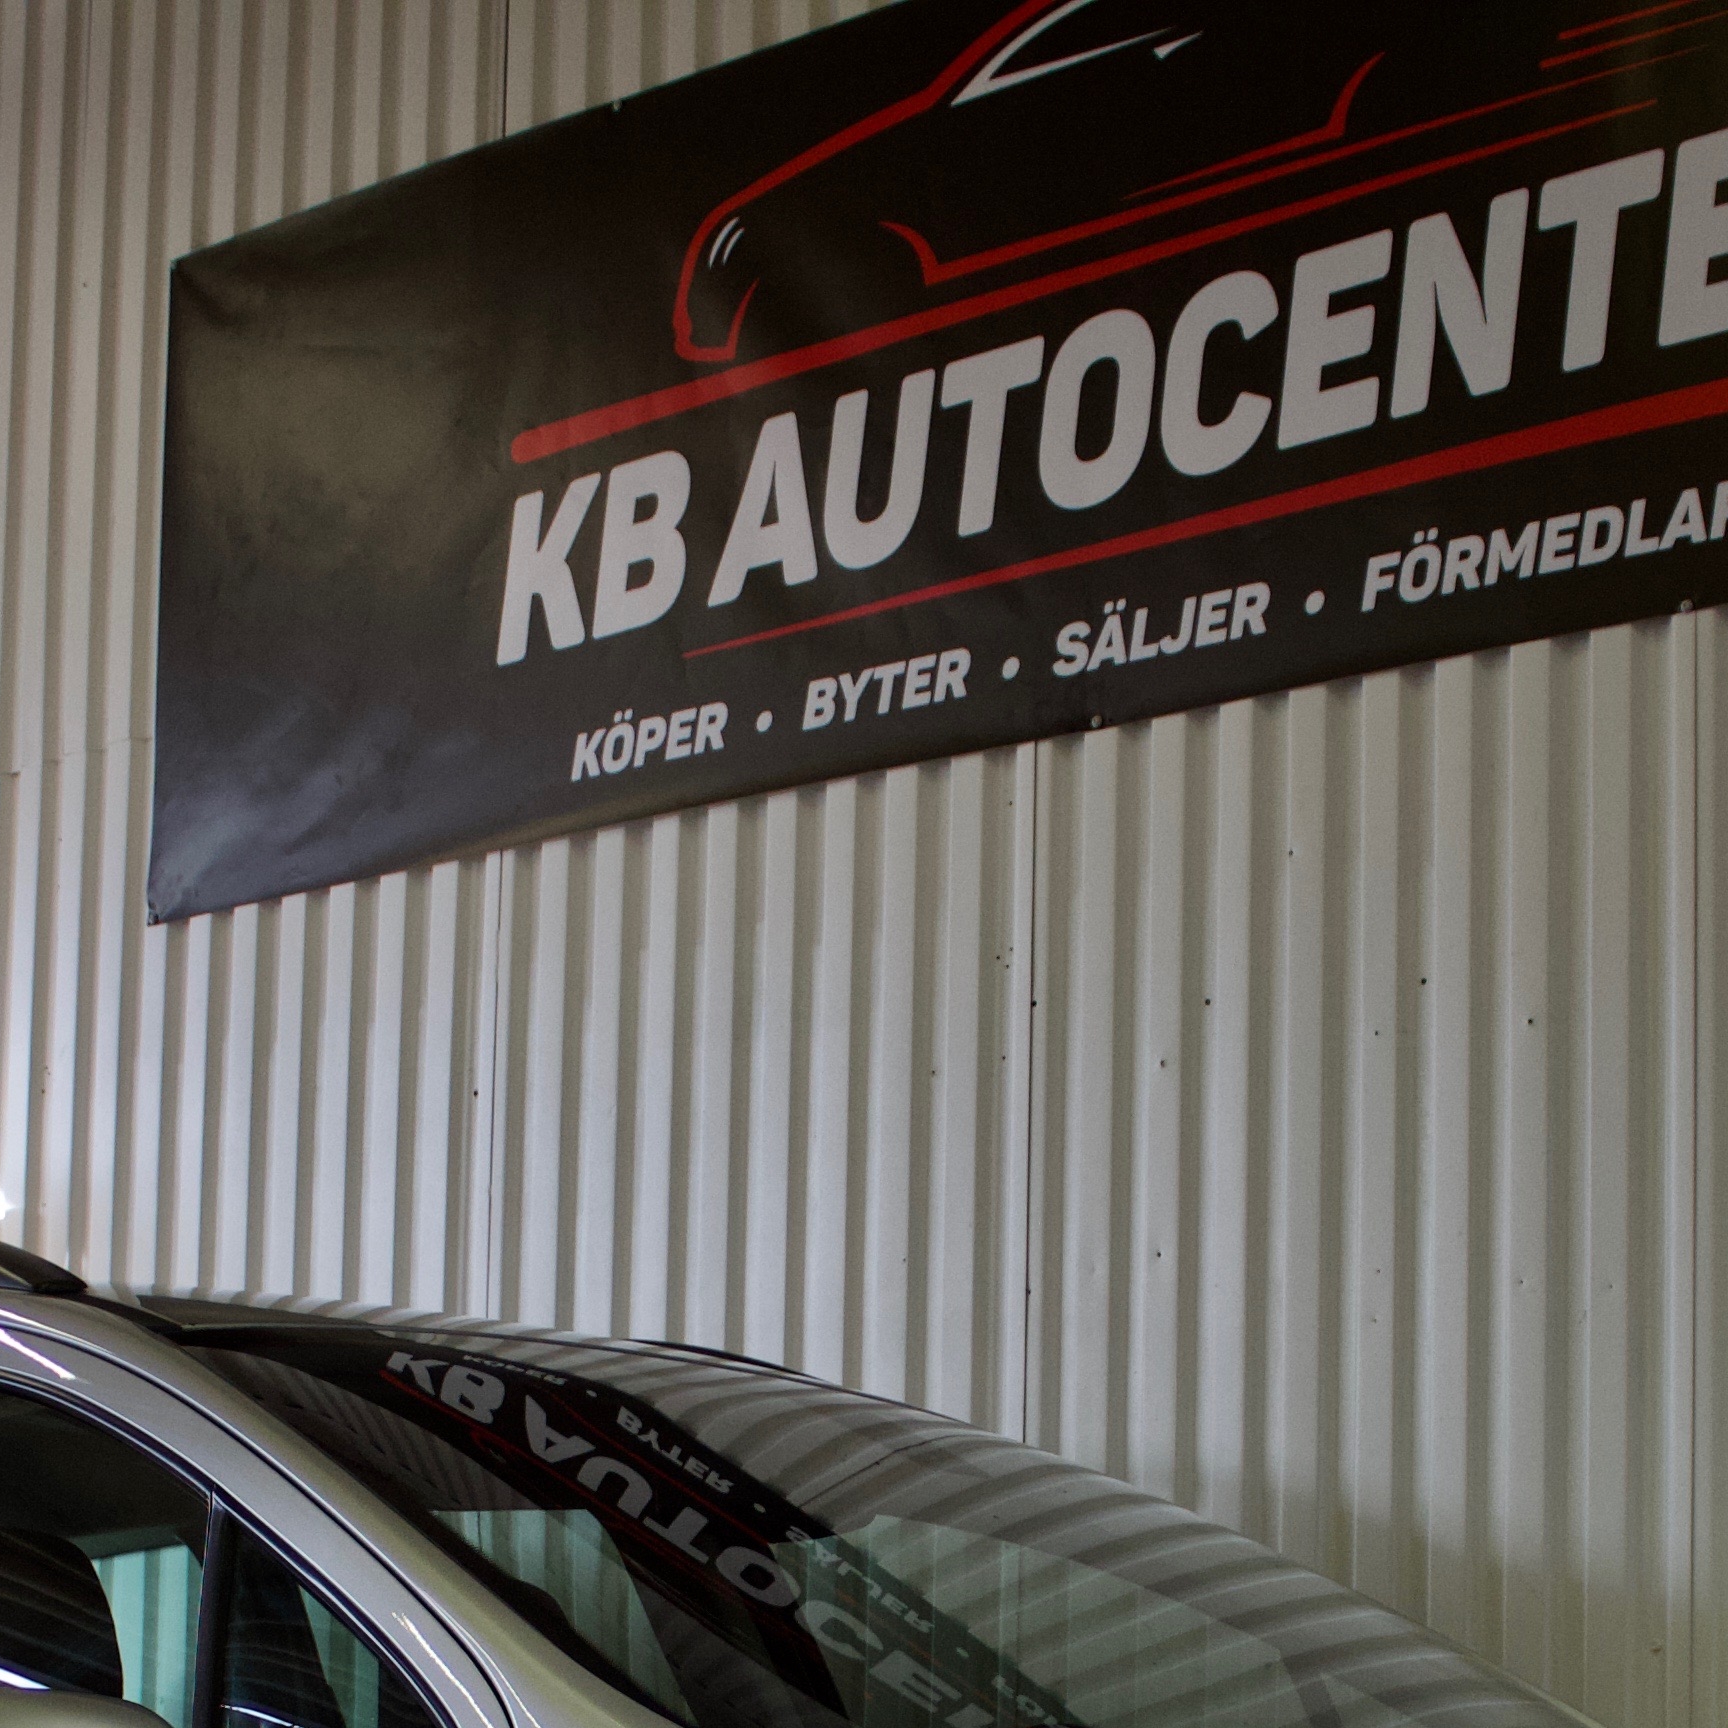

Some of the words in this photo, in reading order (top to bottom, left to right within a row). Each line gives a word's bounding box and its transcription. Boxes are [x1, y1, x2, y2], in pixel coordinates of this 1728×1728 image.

[495, 449, 692, 667] KB
[571, 700, 729, 783] KÖPER
[802, 646, 972, 731] BYTER
[1052, 580, 1272, 678] SÄLJER
